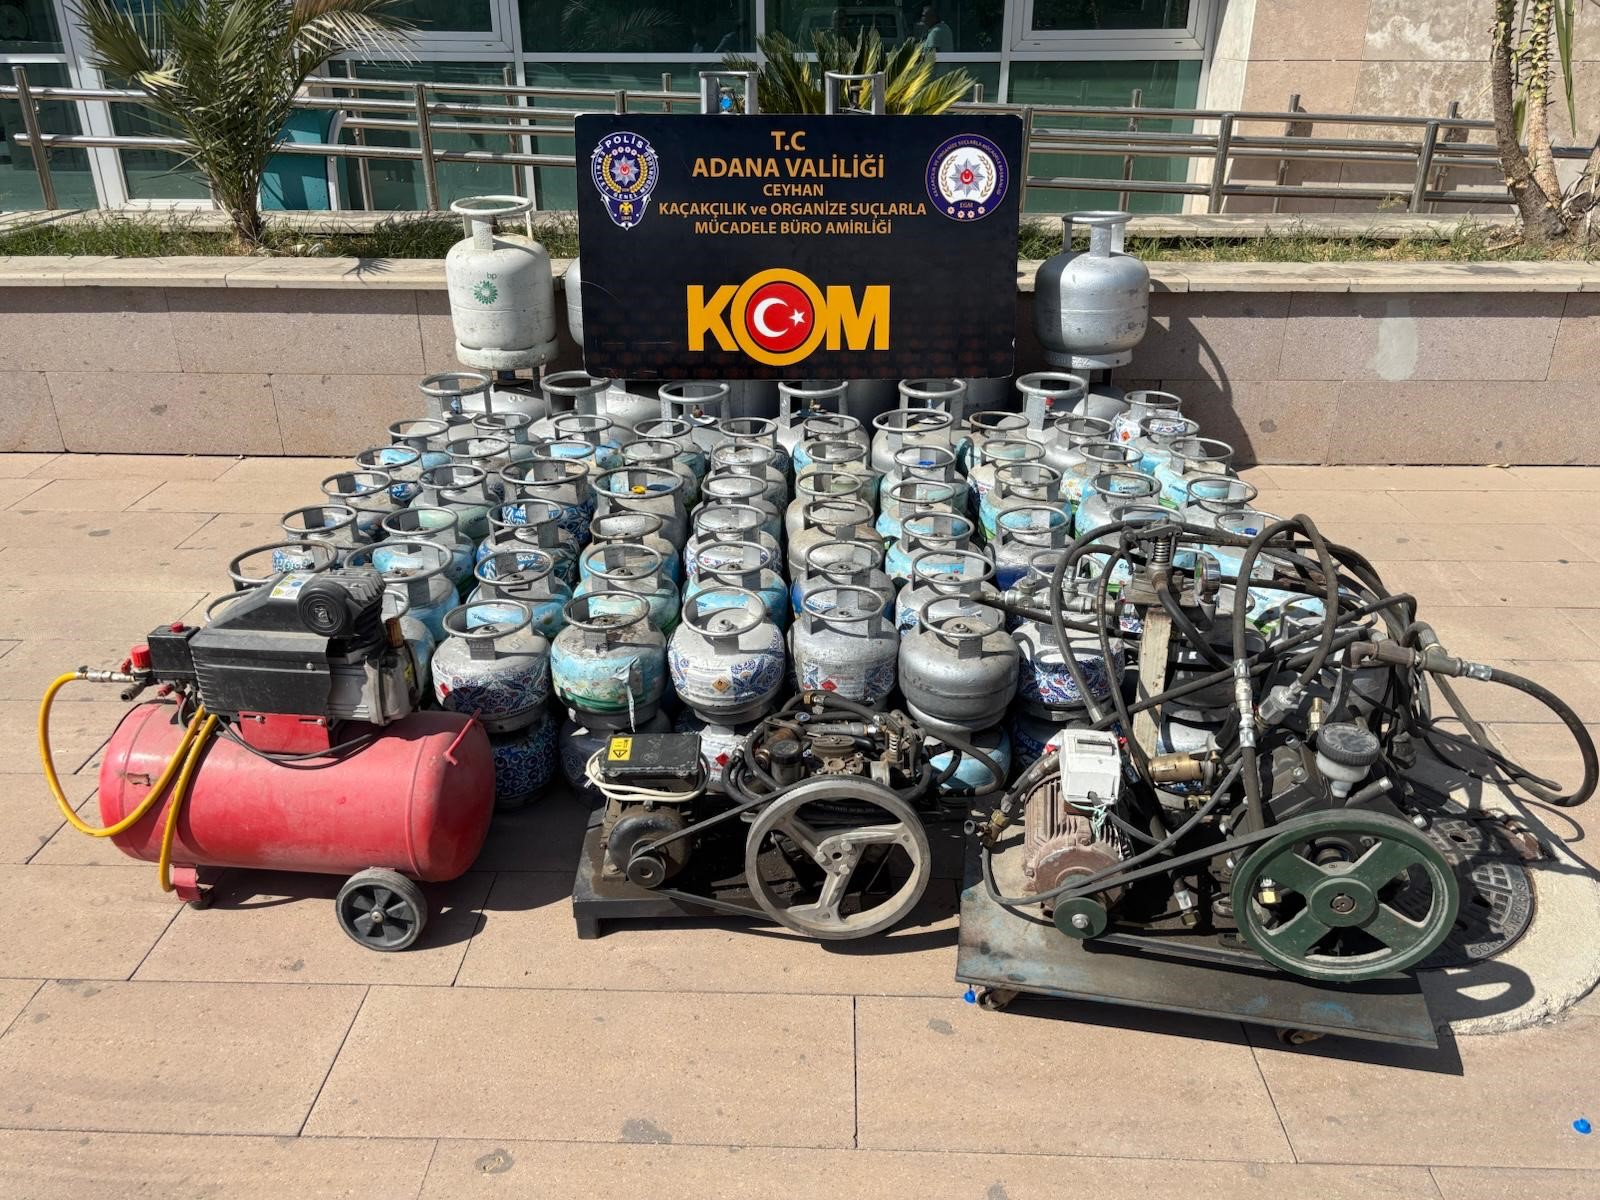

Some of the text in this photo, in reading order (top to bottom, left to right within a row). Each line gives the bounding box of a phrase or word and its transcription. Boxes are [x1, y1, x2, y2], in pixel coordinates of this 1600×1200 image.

[605, 135, 644, 149] POLİS
[771, 131, 806, 151] T.C
[692, 153, 884, 178] ADANA VALİLİĞİ
[763, 183, 824, 197] CEYHAN
[659, 200, 927, 218] KAÇAKÇILIK ve ORGANİZE SUÇLARLA
[694, 219, 892, 234] MÜCADELE BÜRO AMİRLİĞİ
[486, 271, 497, 280] bp
[686, 268, 891, 367] KOM
